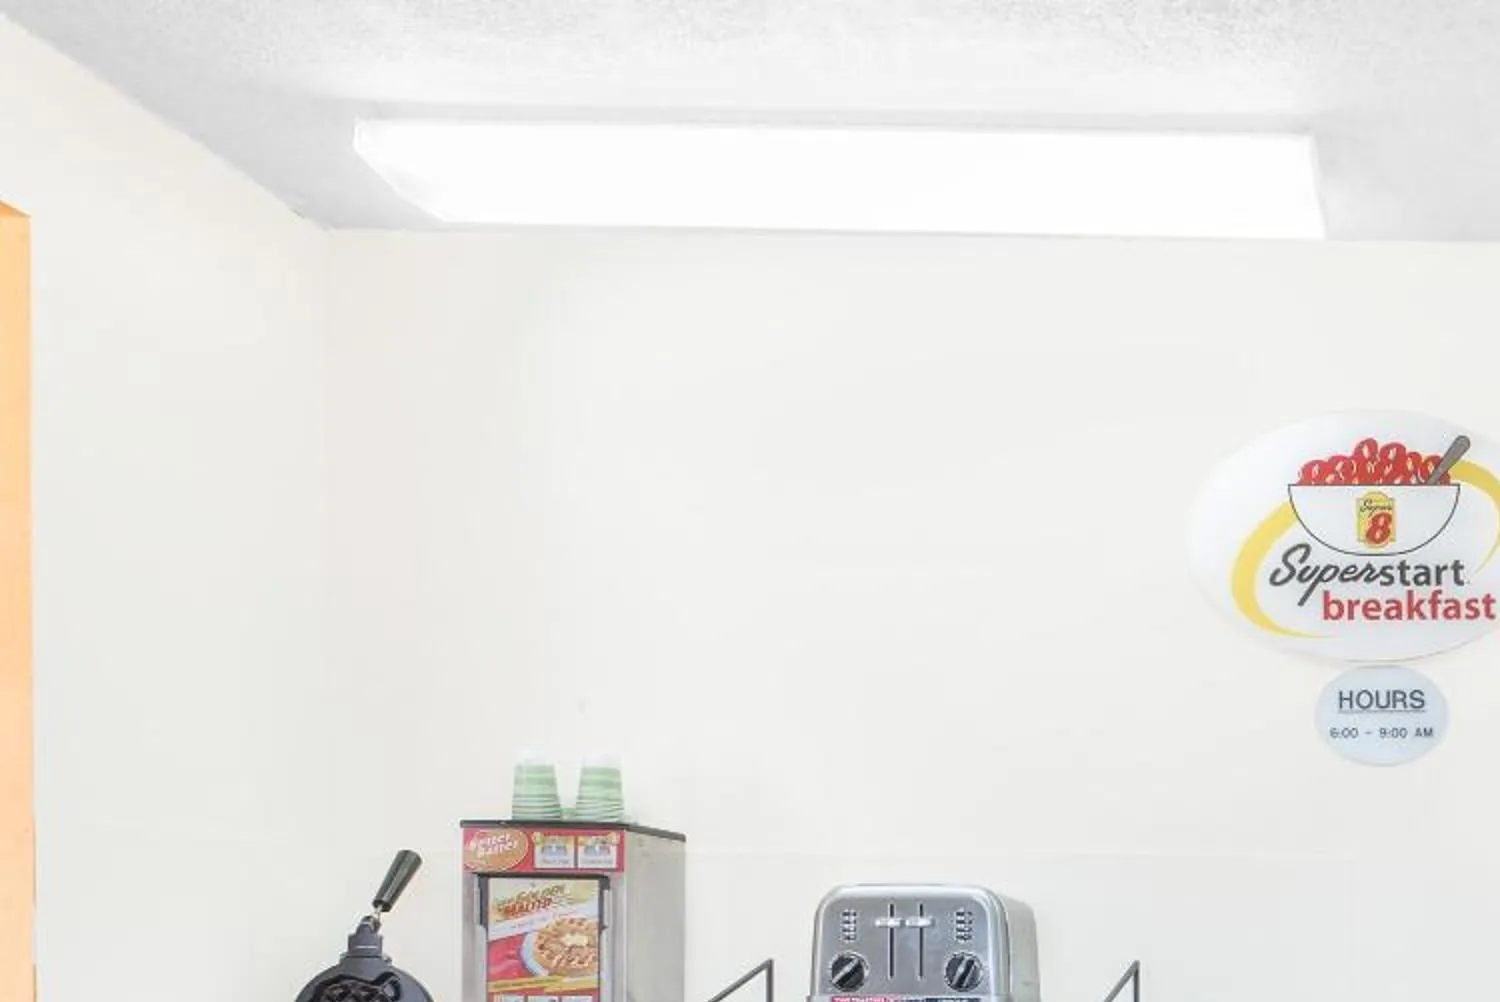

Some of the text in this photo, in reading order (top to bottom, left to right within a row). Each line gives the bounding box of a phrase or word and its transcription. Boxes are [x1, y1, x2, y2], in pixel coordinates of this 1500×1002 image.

[1366, 511, 1393, 544] 8
[1269, 543, 1464, 606] Superstart
[1322, 589, 1497, 621] breakfast
[1338, 688, 1426, 710] HOURS
[1329, 727, 1360, 739] 6:00
[1379, 727, 1408, 739] 9:00
[1415, 727, 1434, 737] AM
